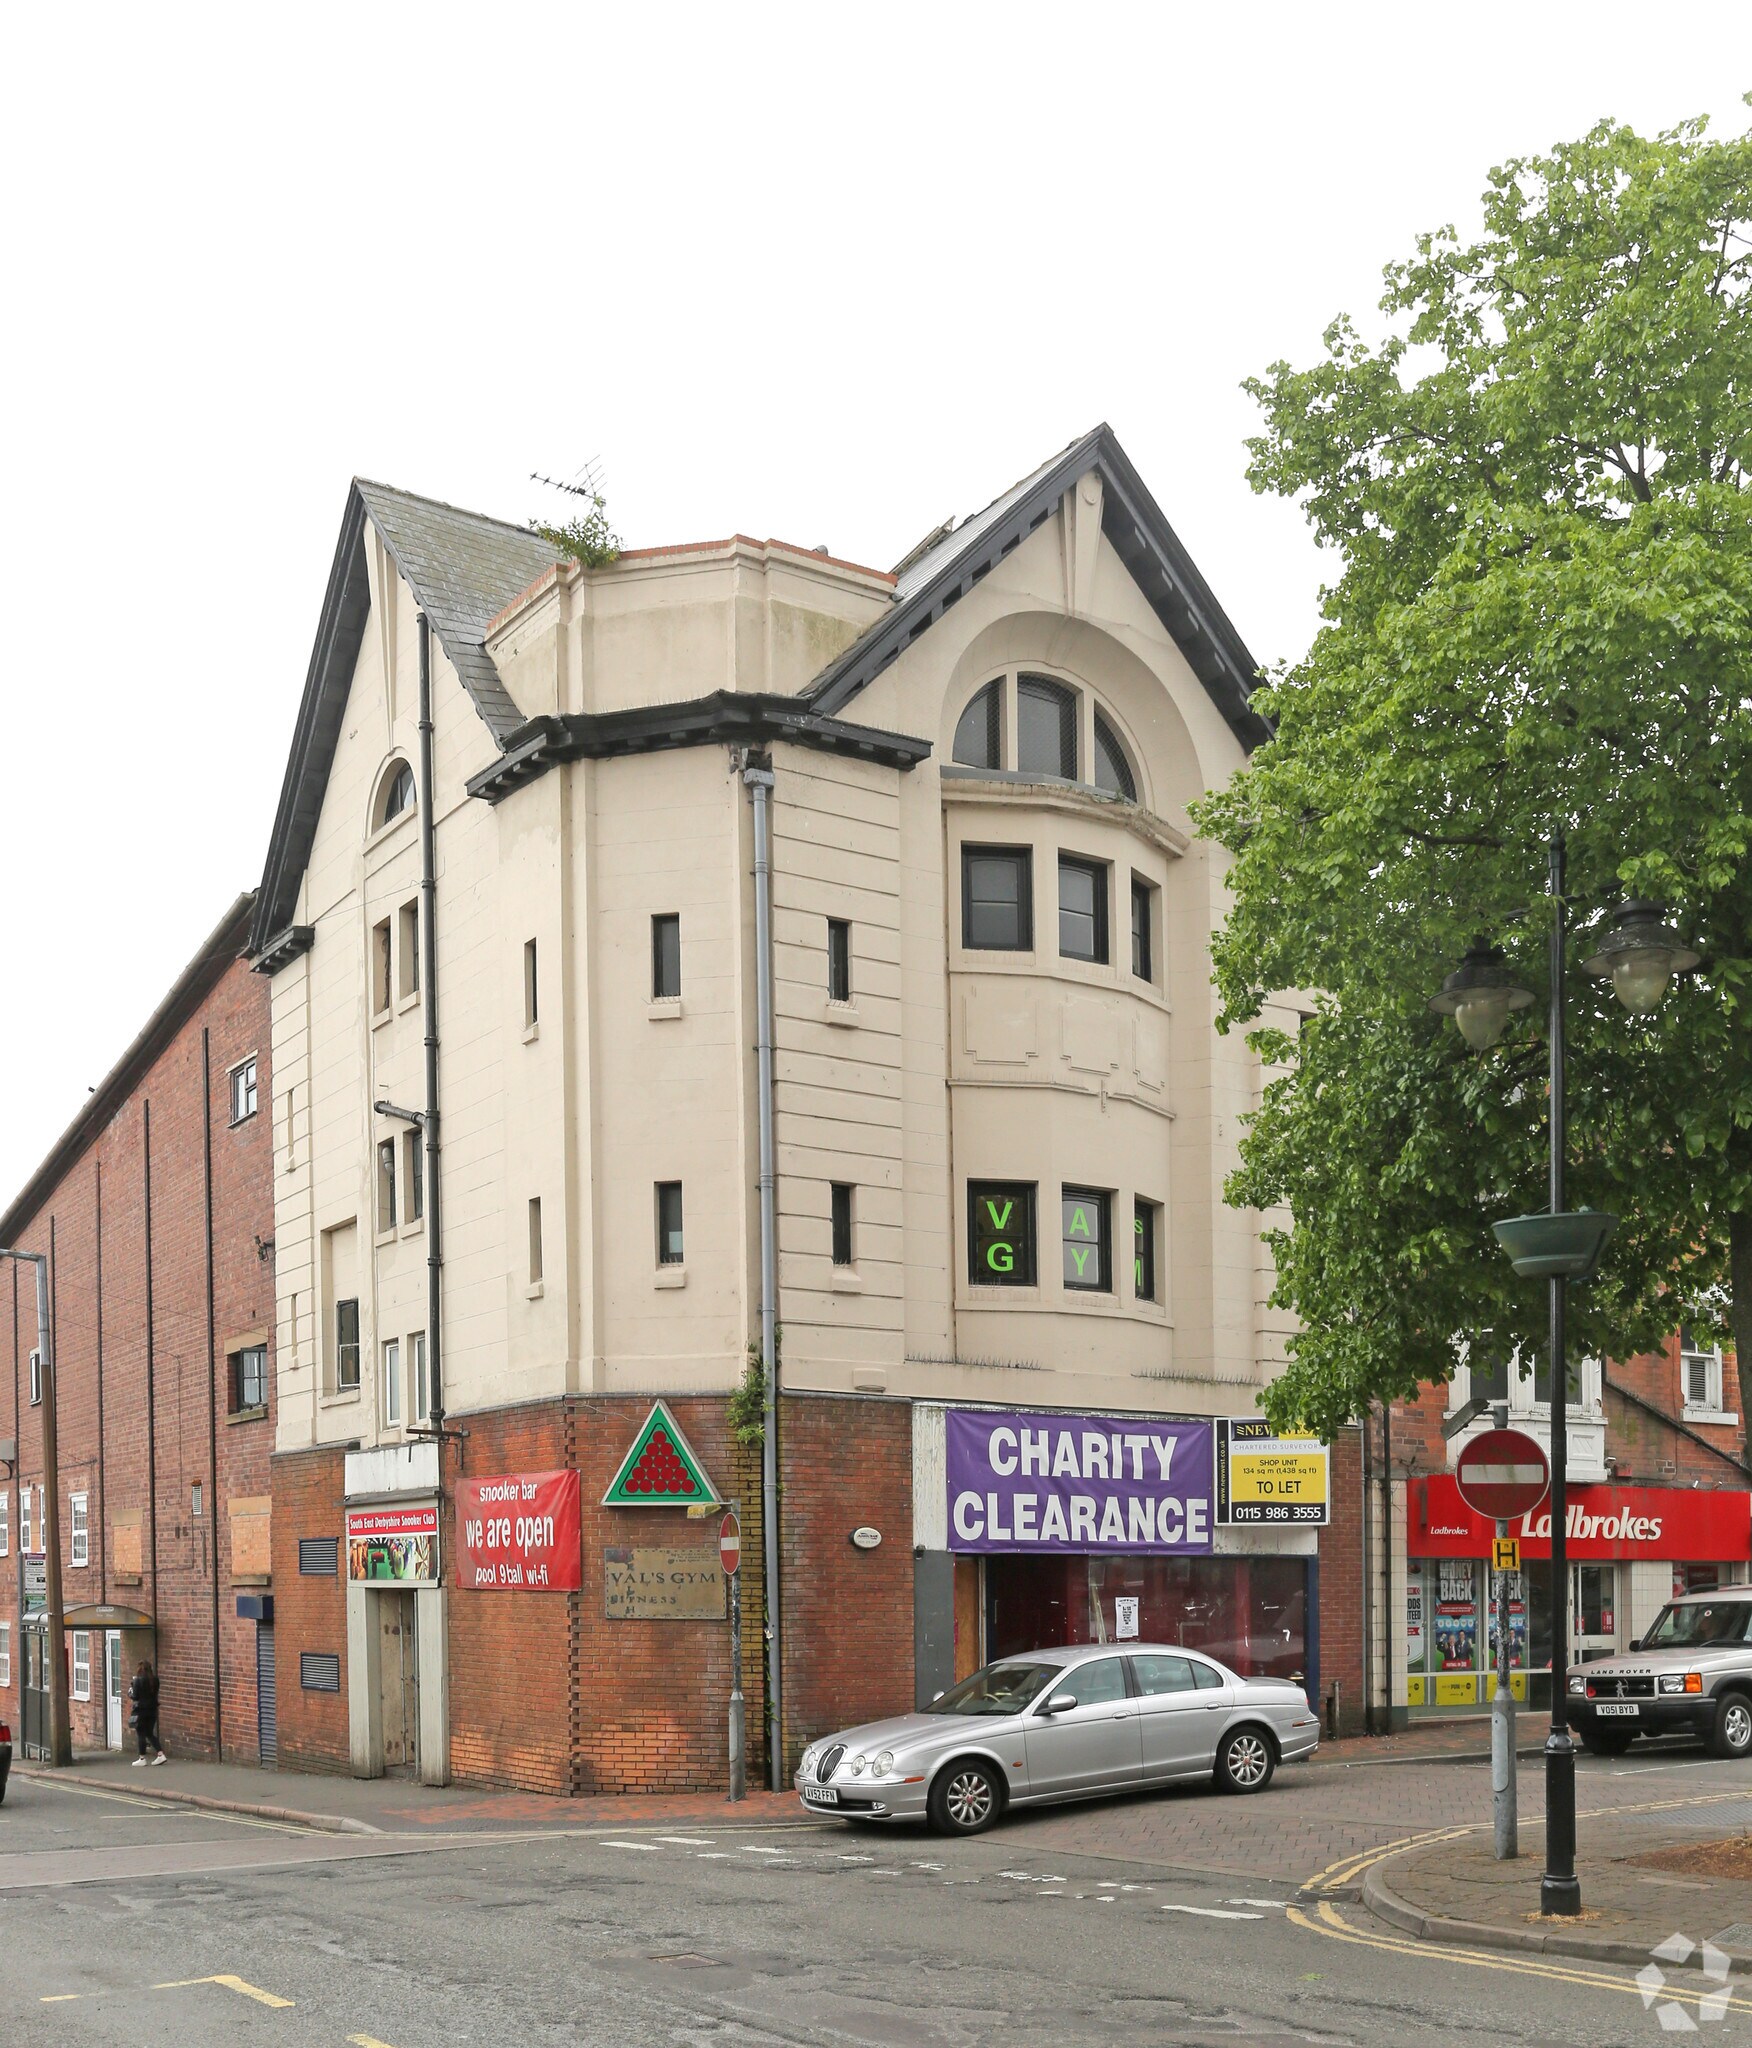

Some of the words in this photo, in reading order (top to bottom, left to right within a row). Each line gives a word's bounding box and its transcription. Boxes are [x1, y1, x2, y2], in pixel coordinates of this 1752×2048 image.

[988, 1426, 1178, 1481] CHARITY
[1233, 1443, 1278, 1451] CHARTERED
[1259, 1459, 1280, 1467] SHOP
[1243, 1467, 1255, 1475] 134
[1257, 1468, 1266, 1476] sq
[1298, 1468, 1307, 1476] sq
[479, 1480, 520, 1502] snooker
[521, 1479, 538, 1500] bar
[1256, 1481, 1274, 1494] TO
[1278, 1481, 1302, 1494] LET
[953, 1490, 1209, 1544] CLEARANCE
[1236, 1507, 1261, 1519] 0115
[1265, 1507, 1289, 1519] 986
[1292, 1507, 1321, 1519] 3555
[350, 1518, 364, 1530] South
[364, 1517, 375, 1528] East
[375, 1515, 401, 1530] Derbyshire
[401, 1514, 422, 1527] Snooker
[423, 1513, 436, 1525] Club
[465, 1519, 484, 1549] we
[487, 1518, 511, 1549] are
[515, 1516, 555, 1557] open
[1430, 1526, 1469, 1535] Ladbrokes
[475, 1563, 497, 1586] pool
[526, 1563, 549, 1585] wi-fi
[1440, 1562, 1473, 1579] MONEY
[611, 1572, 665, 1585] VAL'S
[670, 1572, 717, 1584] GYM
[1440, 1579, 1473, 1601] BACK
[1619, 1705, 1635, 1714] BYD
[822, 1790, 835, 1801] FFN
